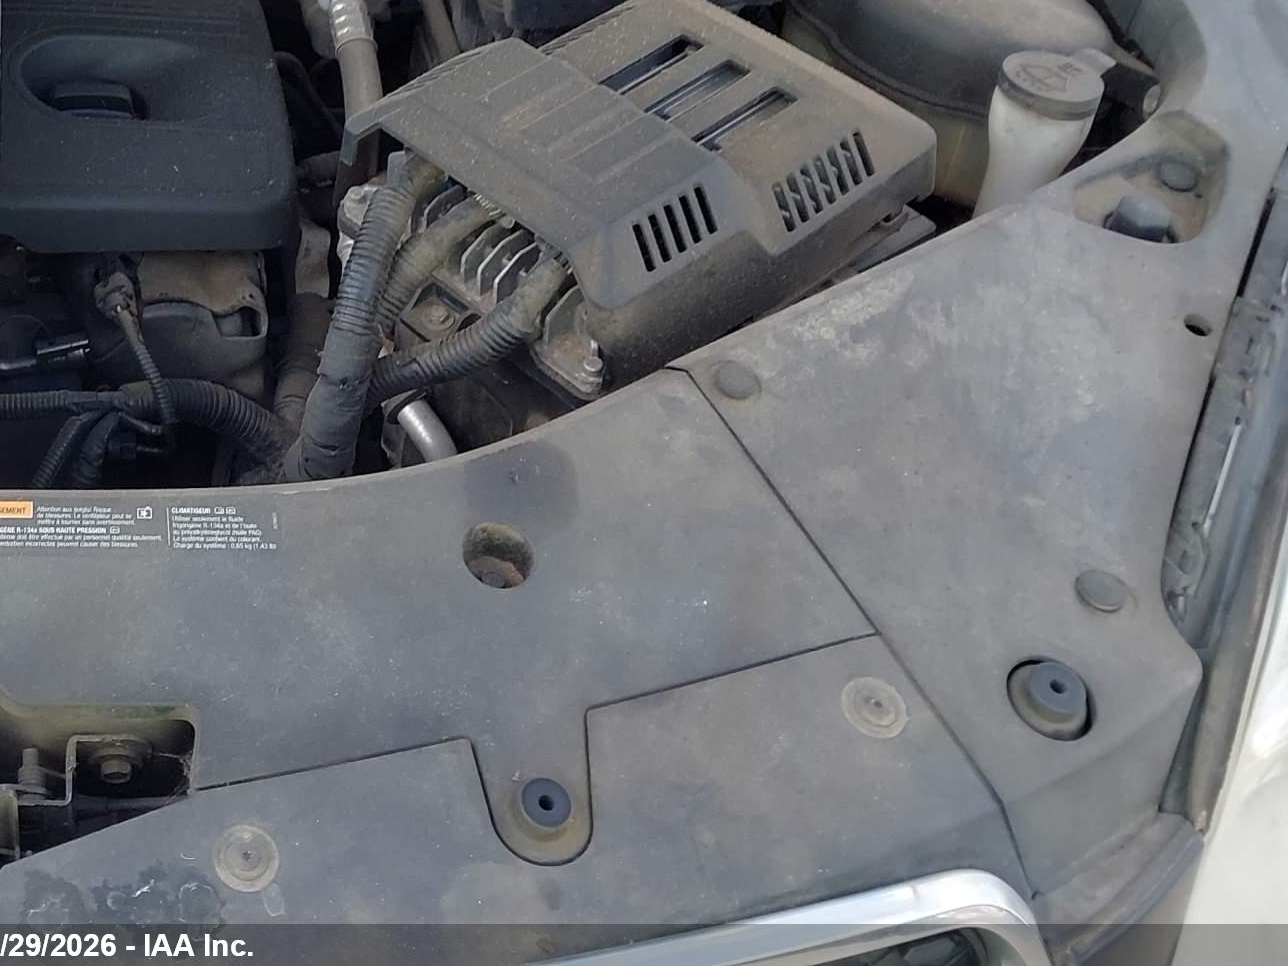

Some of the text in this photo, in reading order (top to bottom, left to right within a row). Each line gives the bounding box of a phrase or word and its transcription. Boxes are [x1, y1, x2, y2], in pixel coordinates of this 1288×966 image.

[171, 507, 212, 515] CLIMATISEUR
[38, 526, 55, 534] SOUS
[55, 526, 76, 534] HAUTE
[76, 526, 107, 534] PRESSION
